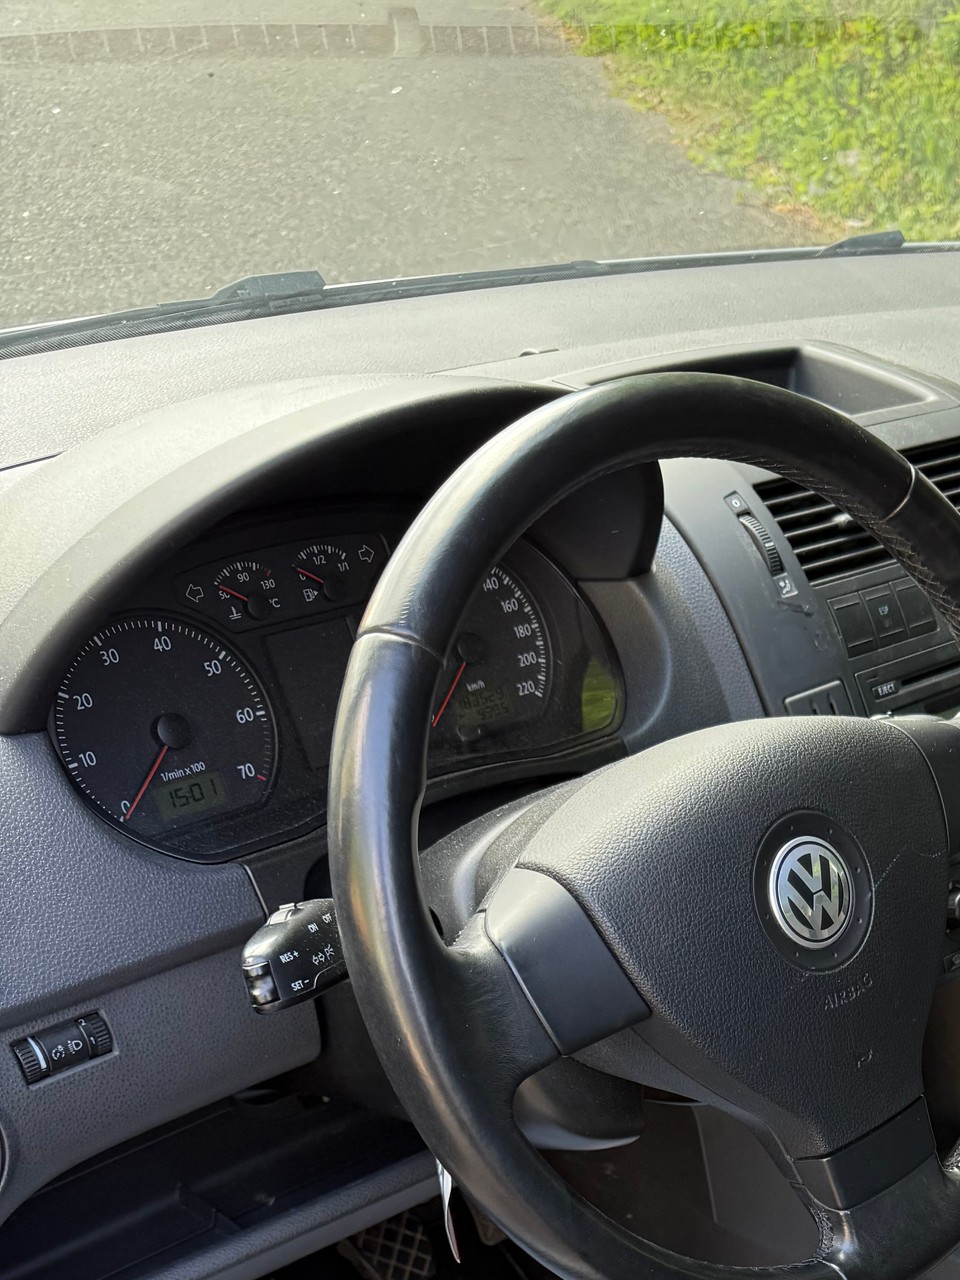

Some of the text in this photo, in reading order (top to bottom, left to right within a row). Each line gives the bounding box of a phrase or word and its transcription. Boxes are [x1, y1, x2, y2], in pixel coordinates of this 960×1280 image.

[313, 555, 327, 565] 1/2
[237, 572, 250, 582] 90
[260, 579, 276, 590] 130
[501, 598, 519, 613] 160
[878, 604, 890, 616] ESP
[513, 623, 532, 639] 180
[153, 635, 172, 652] 40
[99, 648, 120, 666] 30
[517, 651, 537, 667] 200
[203, 659, 223, 677] 50
[466, 679, 486, 692] km/h
[516, 681, 536, 696] 220
[877, 683, 896, 696] EJECT
[72, 692, 93, 711] 20
[235, 707, 255, 725] 60
[78, 751, 97, 768] 10
[160, 769, 185, 783] 1/min
[190, 761, 206, 774] 100
[236, 763, 256, 780] 70
[307, 922, 319, 933] ON
[824, 972, 874, 1012] AIRBAG
